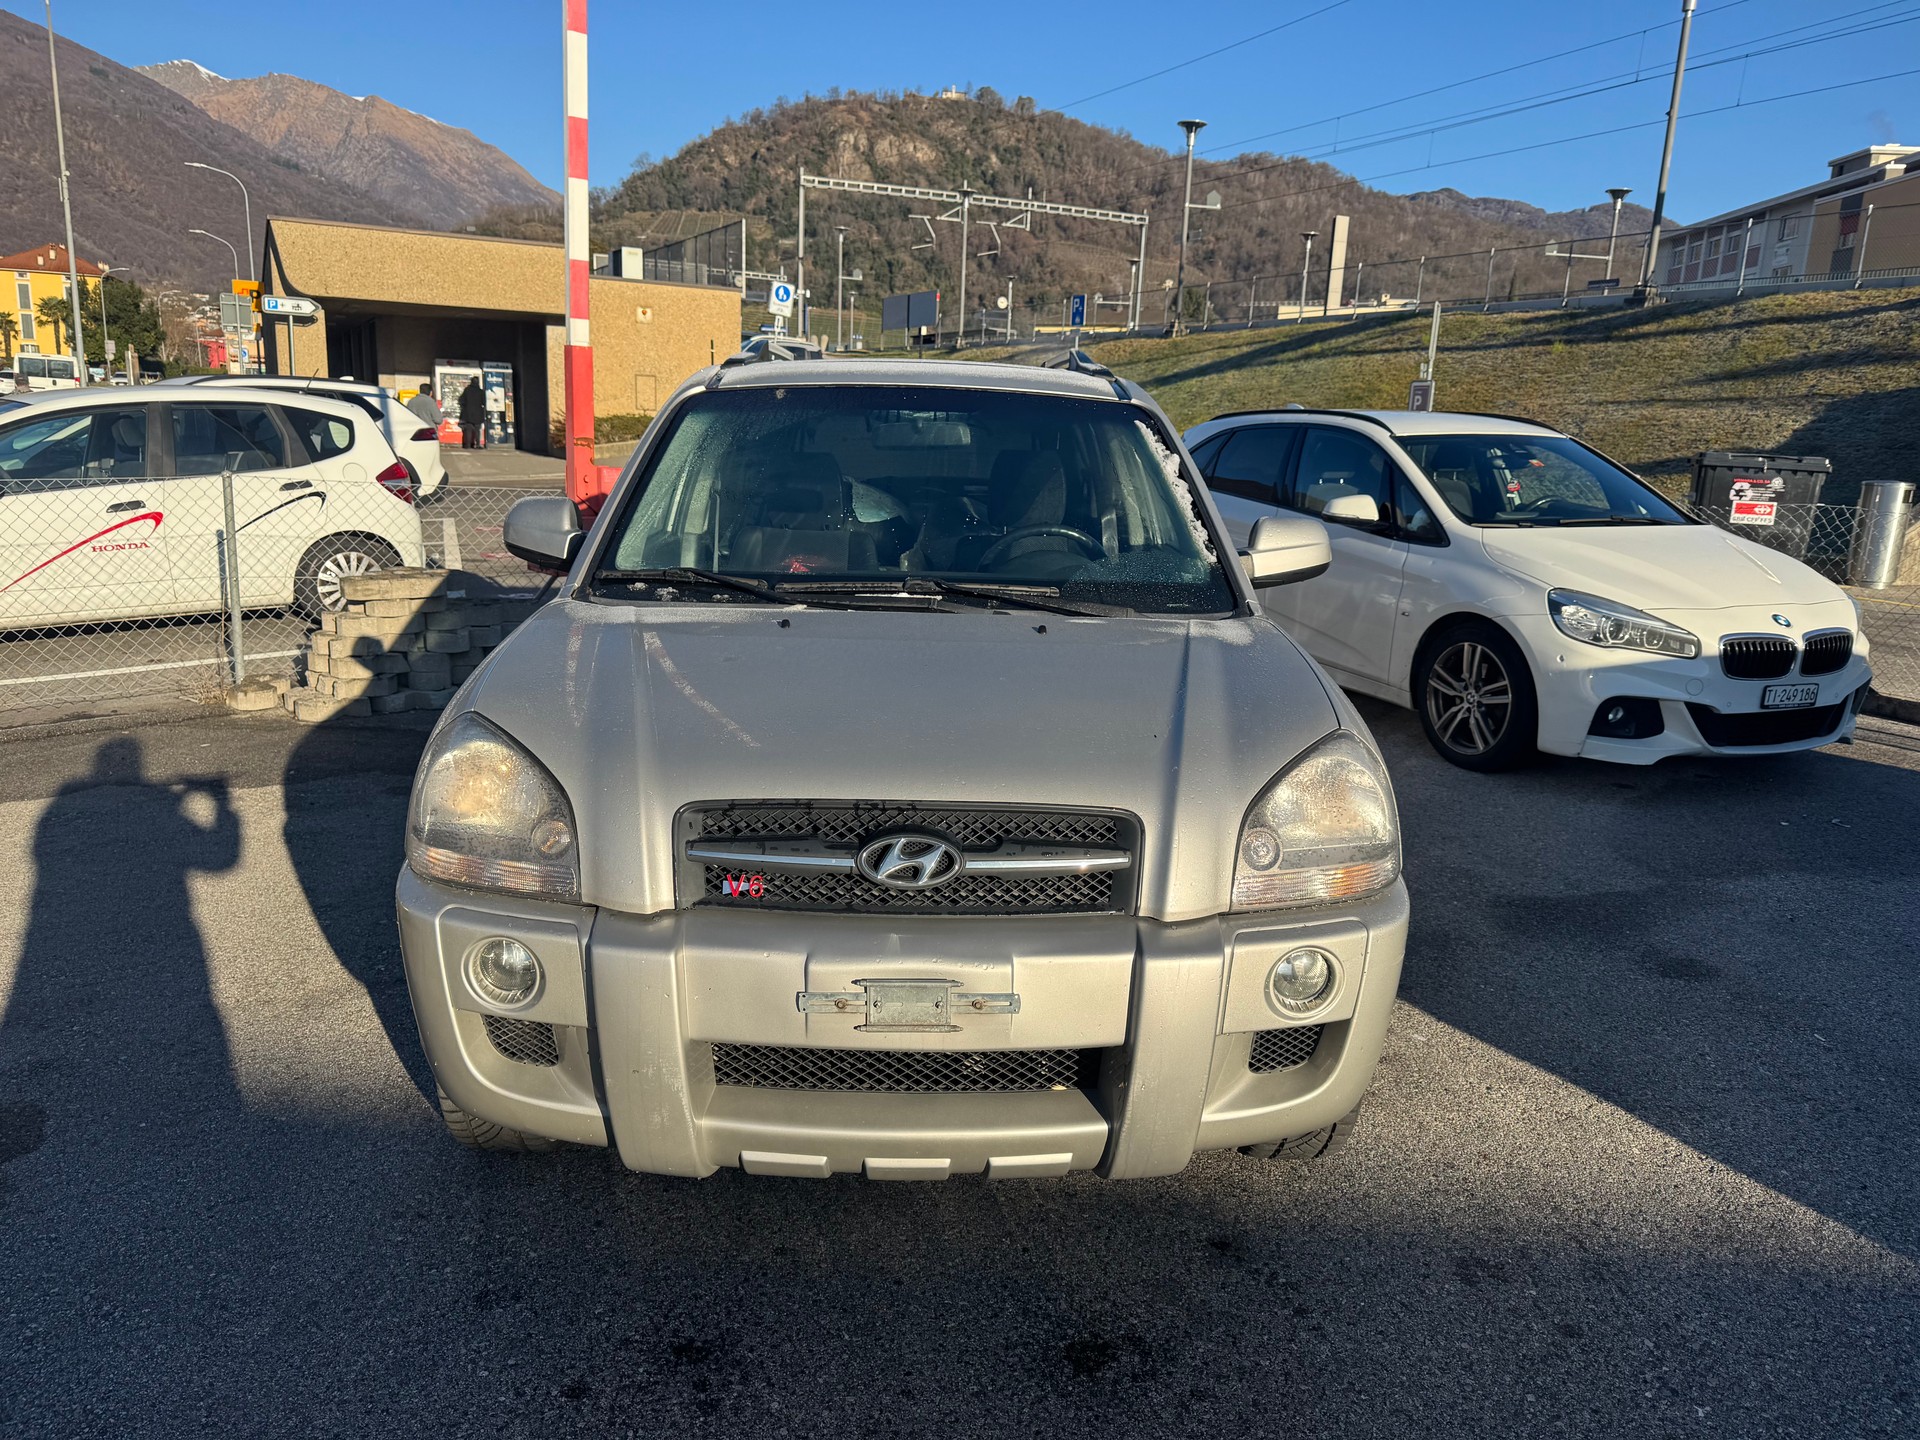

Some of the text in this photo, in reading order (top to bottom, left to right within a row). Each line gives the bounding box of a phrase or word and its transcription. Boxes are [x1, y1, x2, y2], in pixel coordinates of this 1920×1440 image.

[1413, 395, 1422, 410] P
[91, 542, 150, 552] HONDA
[726, 874, 764, 898] V6
